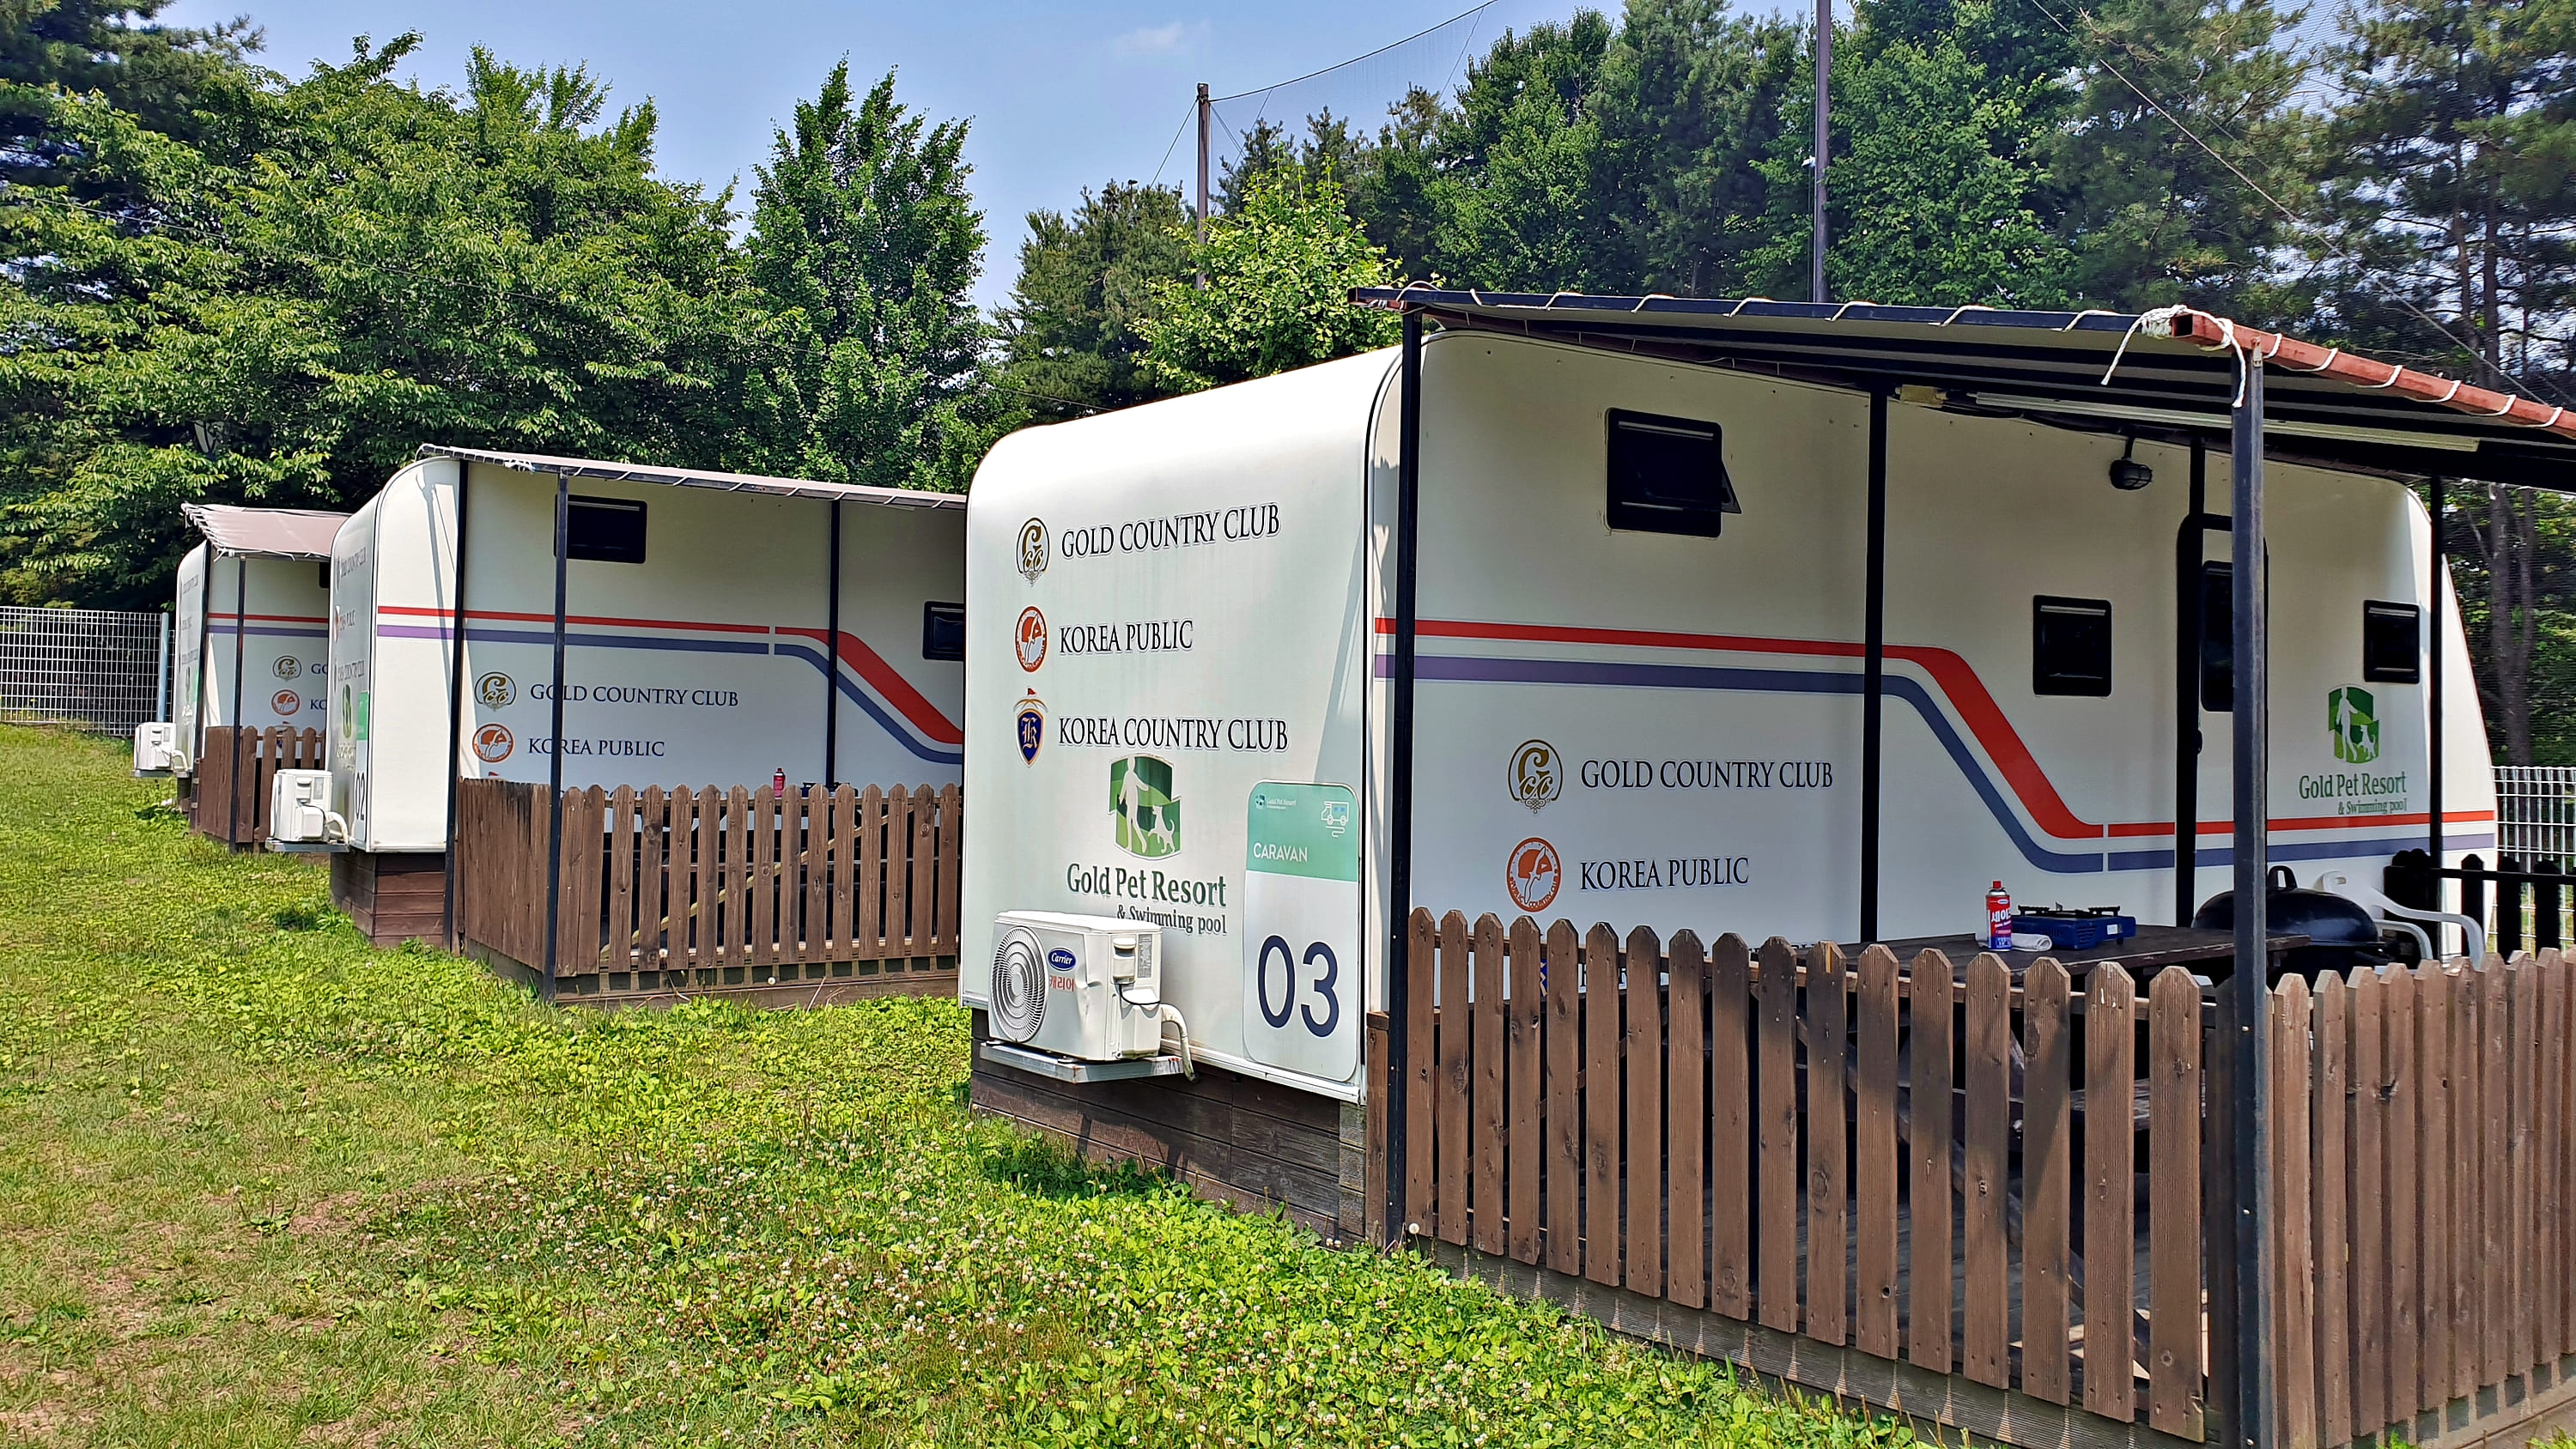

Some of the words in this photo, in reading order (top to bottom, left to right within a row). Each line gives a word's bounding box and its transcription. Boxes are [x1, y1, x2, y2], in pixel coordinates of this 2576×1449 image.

[1061, 526, 1114, 558] GOLD
[1120, 512, 1221, 552] COUNTRY
[1224, 503, 1279, 543] CLUB
[1059, 625, 1121, 654] KOREA
[1127, 620, 1194, 651] PUBLIC
[593, 686, 688, 705] COUNTRY
[691, 689, 738, 706] CLUB
[1059, 718, 1119, 746] KOREA
[1124, 718, 1224, 749] COUNTRY
[1228, 719, 1288, 750] CLUB
[598, 740, 665, 757] PUBLIC
[1581, 760, 1653, 788] GOLD
[1660, 761, 1774, 788] COUNTRY
[1779, 762, 1832, 788] CLUB
[2300, 775, 2333, 798] Gold
[2336, 773, 2359, 797] Pet
[2361, 771, 2406, 794] Resort
[355, 772, 366, 820] 02
[2338, 802, 2344, 815] &
[1254, 843, 1307, 862] CARAVAN
[1067, 864, 1110, 894] Gold
[1116, 868, 1146, 898] Pet
[1152, 870, 1226, 906] Resort
[1580, 859, 1662, 890] KOREA
[1668, 858, 1748, 886] PUBLIC
[1117, 905, 1125, 919] &
[1129, 906, 1193, 932] Swimming
[1198, 915, 1226, 934] pool
[1052, 953, 1072, 964] Carrier
[1050, 975, 1074, 991] 캐리어
[1258, 935, 1340, 1037] 03
